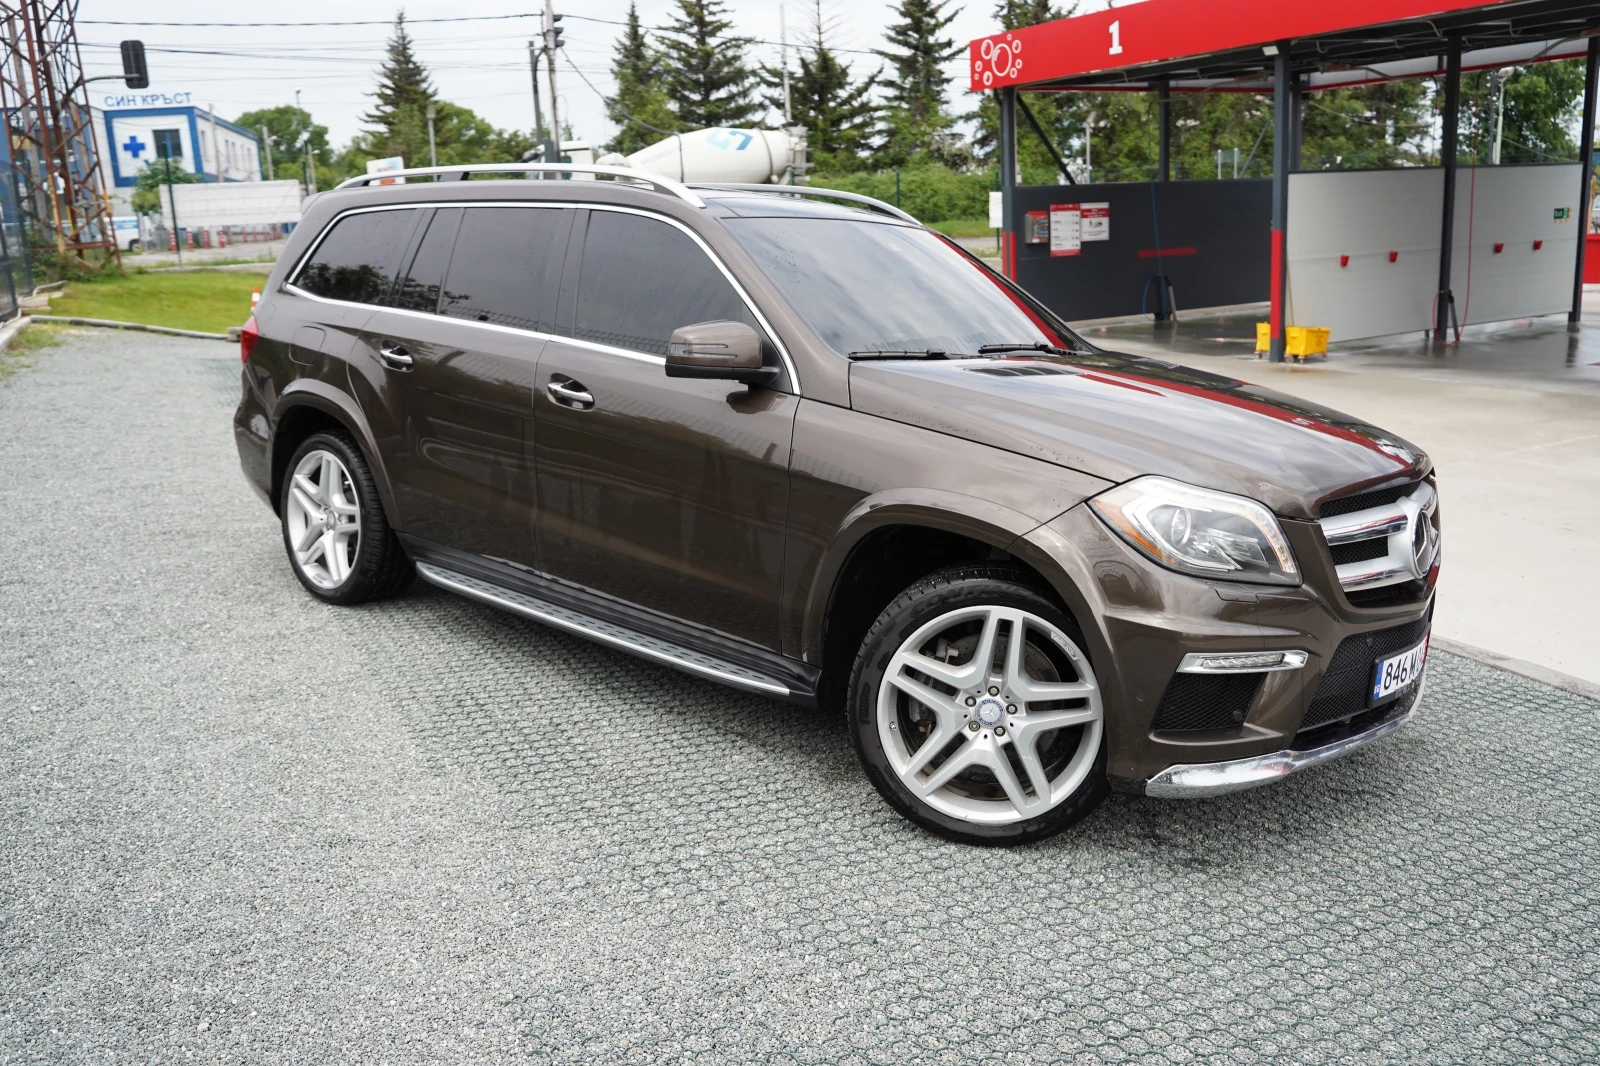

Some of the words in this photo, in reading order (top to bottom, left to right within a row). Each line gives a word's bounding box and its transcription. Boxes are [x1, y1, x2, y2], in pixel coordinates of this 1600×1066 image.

[1109, 20, 1123, 55] 1
[104, 95, 137, 107] СИН
[141, 92, 191, 106] КРЪСТ
[1383, 655, 1408, 690] 846
